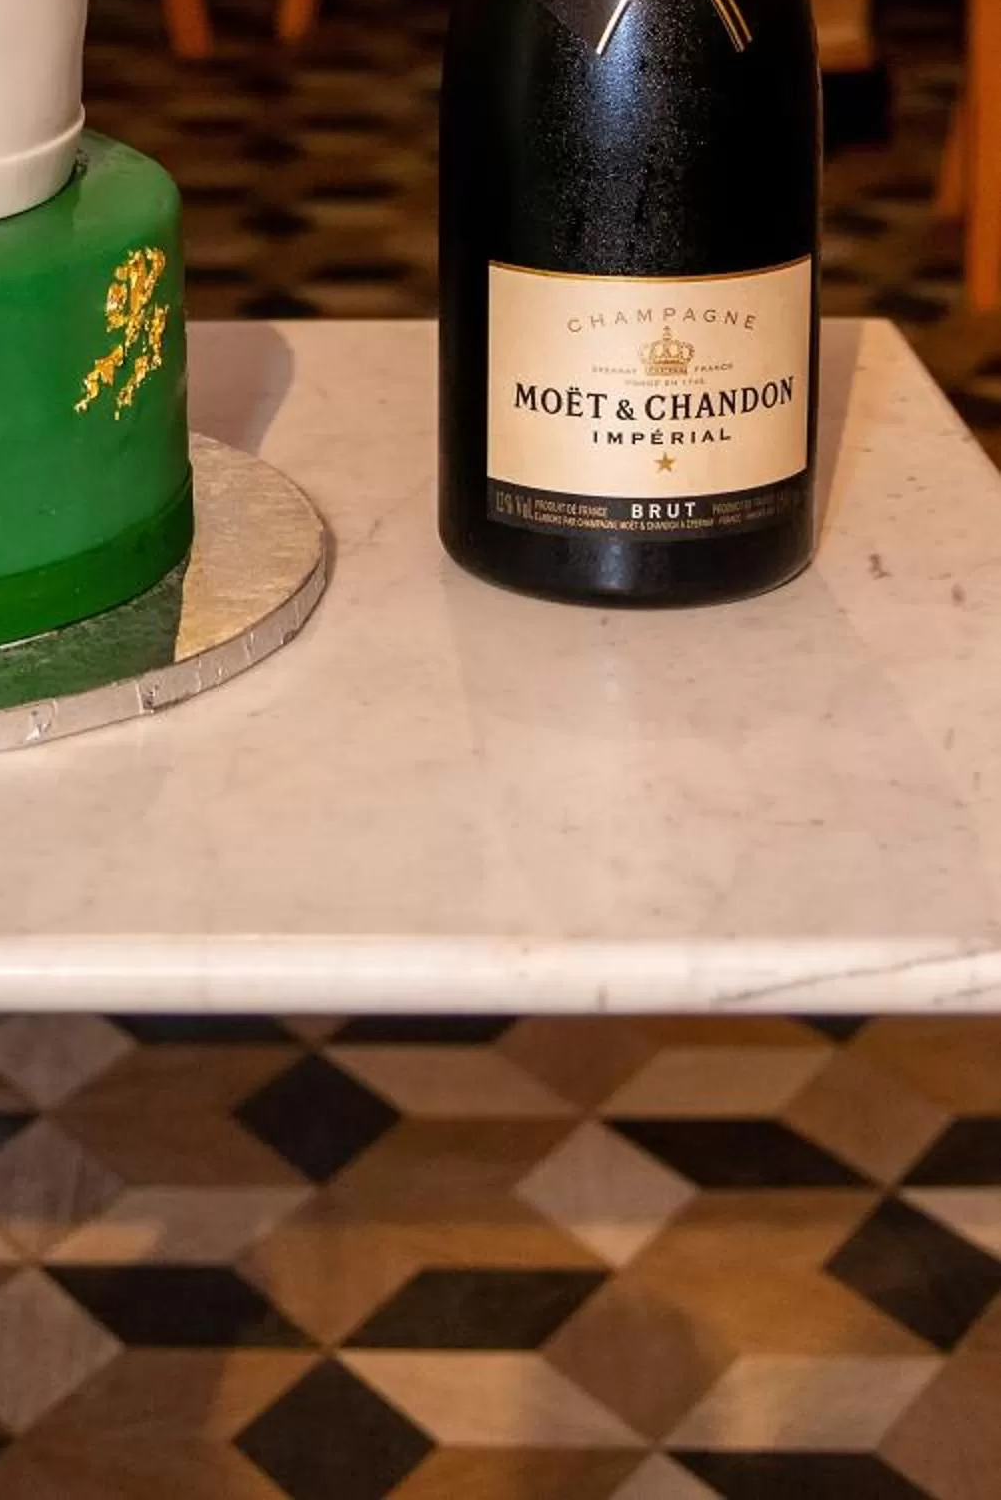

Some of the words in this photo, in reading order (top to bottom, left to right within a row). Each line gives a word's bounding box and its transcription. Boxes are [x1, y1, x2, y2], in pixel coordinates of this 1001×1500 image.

[566, 307, 757, 333] CHAMPAGNE
[514, 382, 608, 419] MOËT
[616, 398, 637, 421] &
[644, 376, 795, 421] CHANDON
[592, 427, 732, 445] IMPÉRIAL
[631, 501, 696, 519] BRUT
